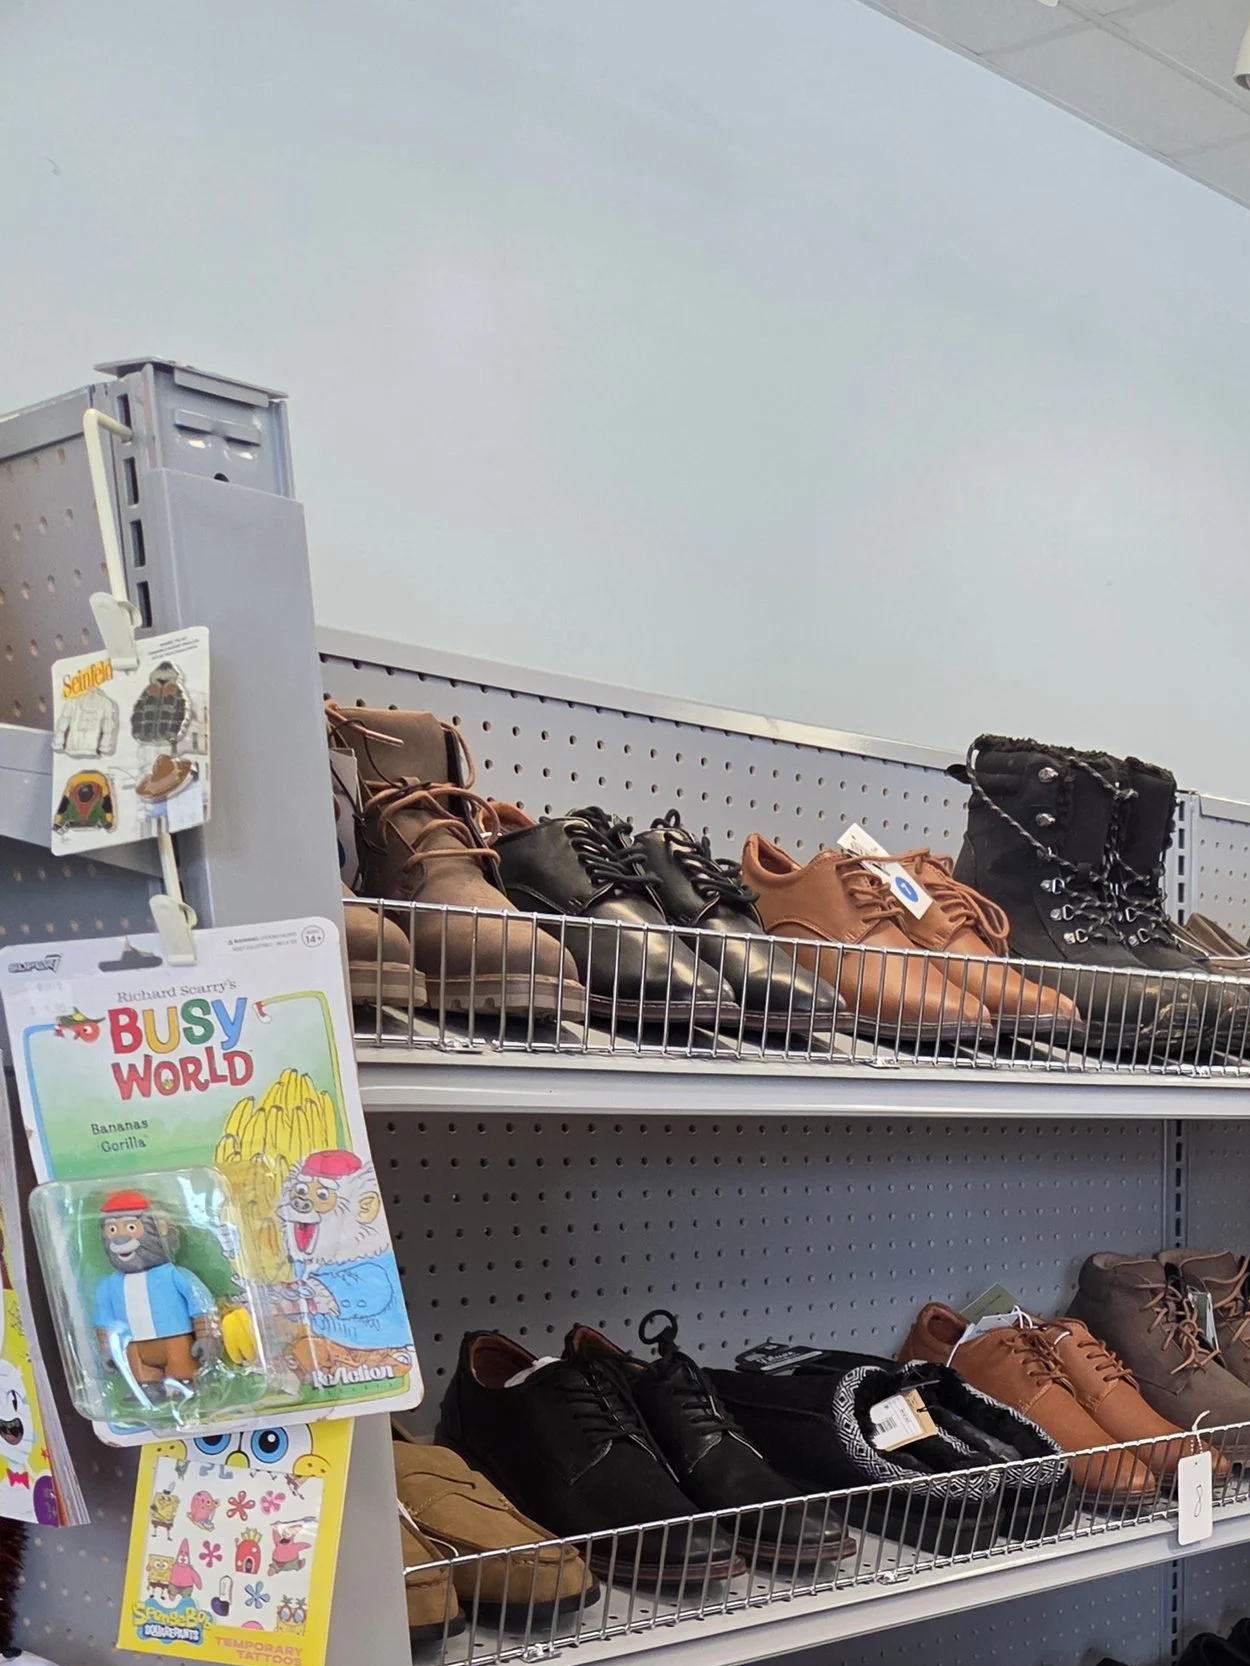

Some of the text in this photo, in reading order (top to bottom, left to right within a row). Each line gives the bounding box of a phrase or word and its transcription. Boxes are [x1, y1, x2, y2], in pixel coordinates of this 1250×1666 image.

[62, 658, 113, 697] Seinfeld
[117, 979, 237, 1003] Richard Scarry's
[108, 997, 248, 1054] BUSY
[111, 1046, 254, 1101] WORLD
[90, 1119, 149, 1136] Bananas
[101, 1136, 147, 1153] Gorilla
[215, 1636, 304, 1656] TEMPORARY
[236, 1650, 303, 1666] TATTOOS
